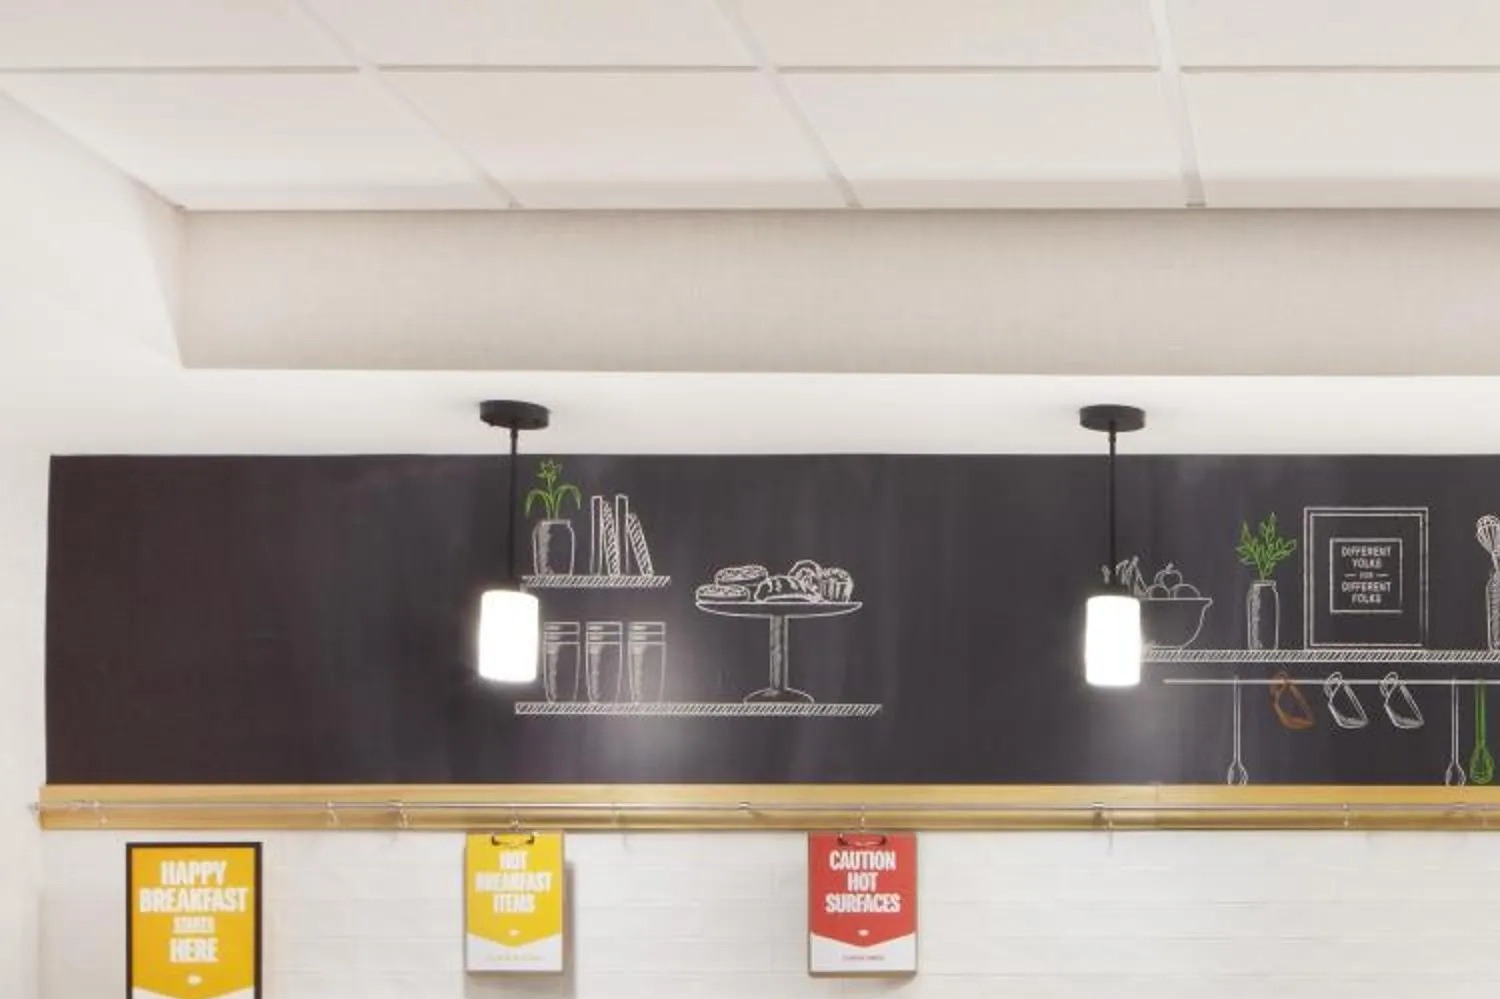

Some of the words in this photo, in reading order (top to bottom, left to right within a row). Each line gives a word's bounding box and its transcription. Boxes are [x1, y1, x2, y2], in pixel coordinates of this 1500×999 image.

[1341, 545, 1390, 557] DIFFERENT
[1341, 581, 1390, 593] DIFFERENT
[1351, 593, 1382, 604] FOLKS
[500, 850, 528, 870] HOT
[829, 850, 896, 870] CAUTION
[160, 860, 228, 885] HAPPY
[475, 872, 552, 892] BREAKFAST
[847, 872, 878, 892] HOT
[139, 887, 248, 912] BREAKFAST
[494, 894, 535, 913] ITEMS
[825, 893, 901, 913] SURFACES
[169, 938, 219, 962] HERE
